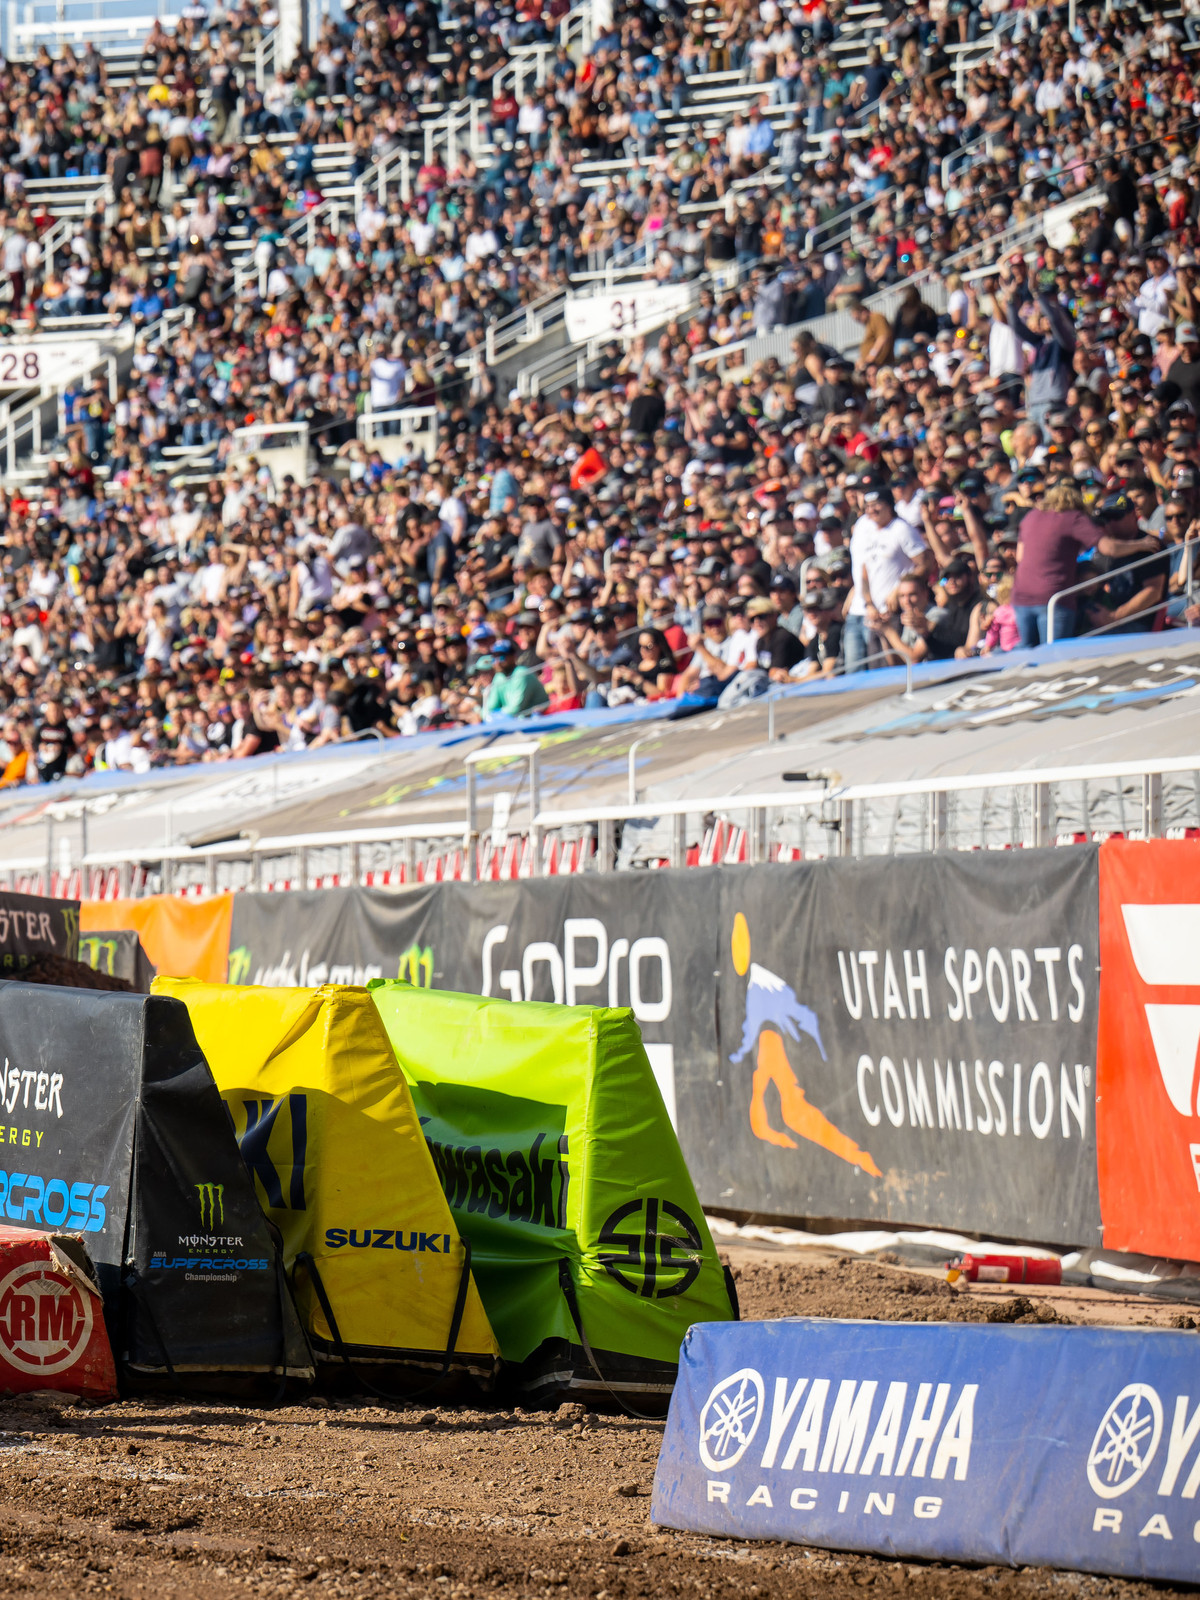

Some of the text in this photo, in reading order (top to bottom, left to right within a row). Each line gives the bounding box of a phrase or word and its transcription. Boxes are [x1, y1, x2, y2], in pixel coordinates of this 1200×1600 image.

[611, 299, 636, 331] 31
[1, 352, 40, 381] 28
[481, 917, 672, 1023] GoPro
[837, 943, 1086, 1023] UTAH SPORTS
[856, 1054, 1088, 1140] COMMISSION
[178, 1234, 244, 1247] MONSTER
[324, 1228, 451, 1254] SUZUKI
[150, 1257, 270, 1270] SUPERCROSS
[184, 1272, 237, 1283] Championship
[10, 1294, 74, 1341] RM
[759, 1376, 980, 1481] YAMAHA
[706, 1480, 944, 1519] RACING
